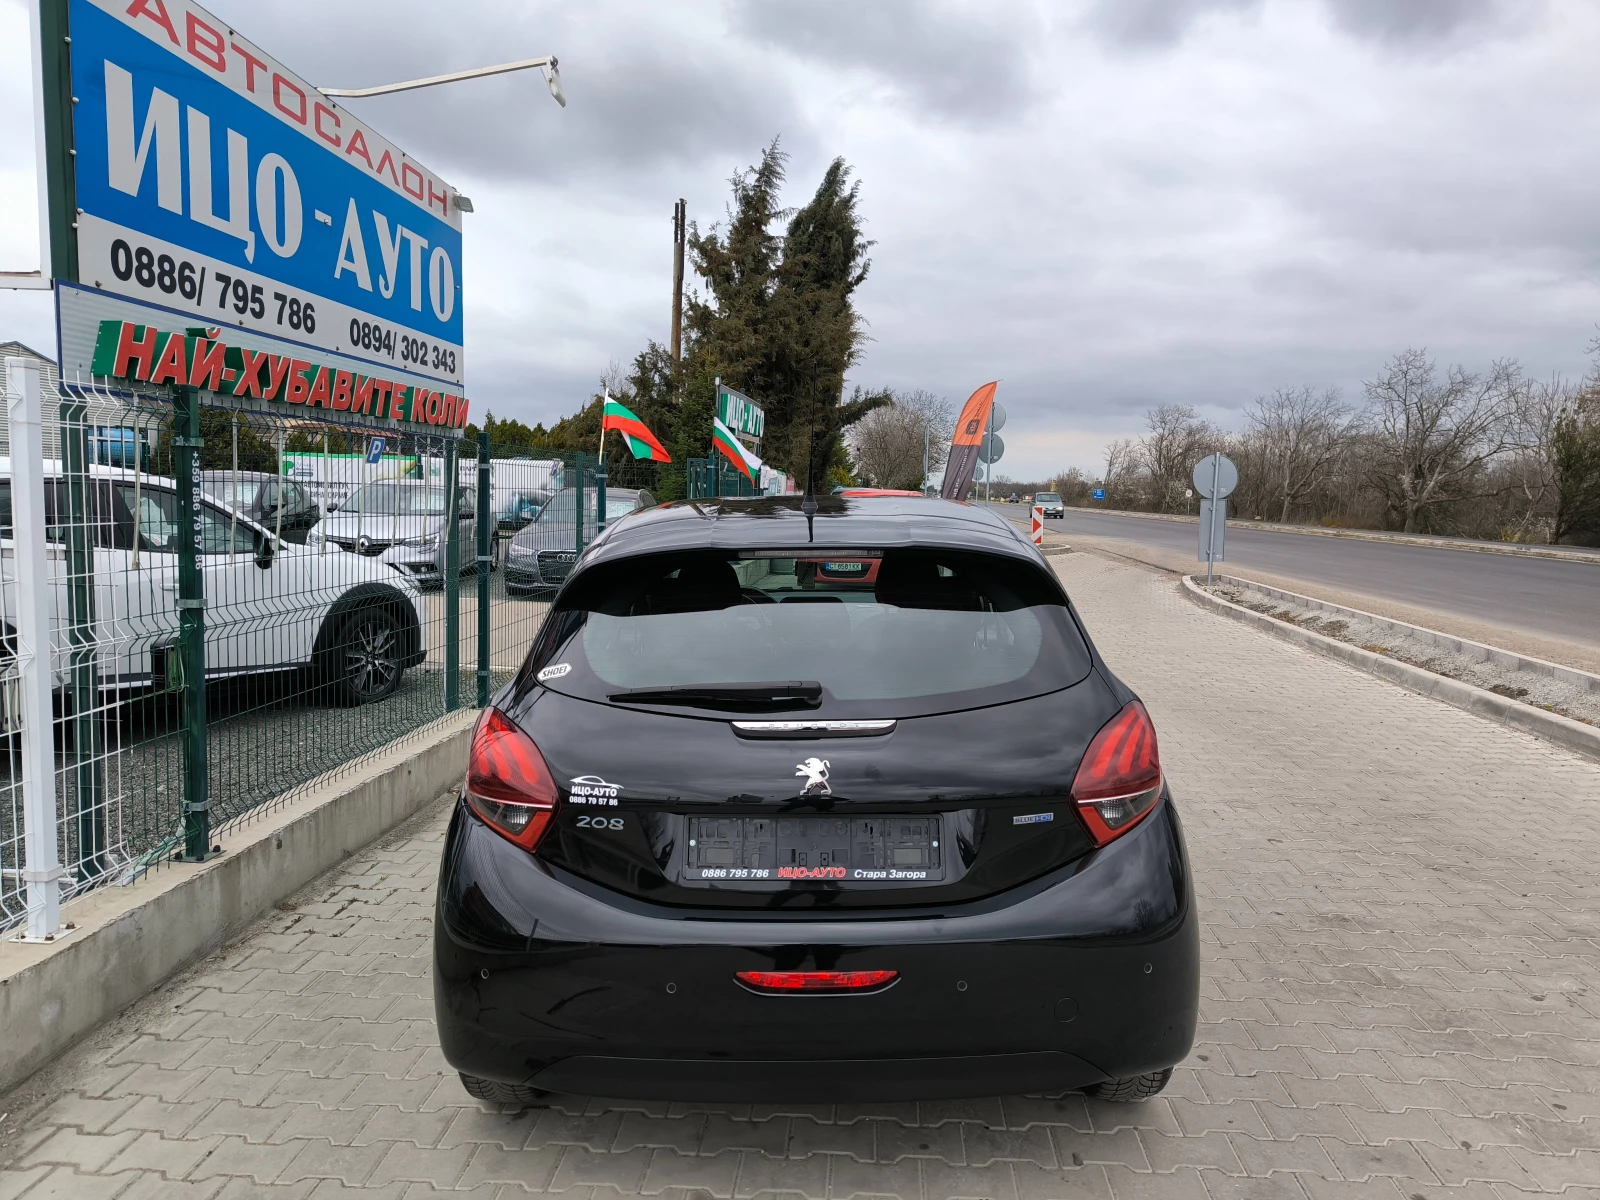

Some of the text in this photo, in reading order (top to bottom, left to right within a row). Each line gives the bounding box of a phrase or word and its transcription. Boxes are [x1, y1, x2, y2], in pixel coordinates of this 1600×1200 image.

[126, 0, 448, 217] АВТОСАЛОН
[110, 238, 316, 334] 0886/ 795 786
[350, 317, 456, 374] 0894/ 302 343
[112, 320, 470, 429] НАЙ-ХУБАВИТЕ КОЛИ
[191, 450, 203, 570] +359 886 79 57 86
[541, 665, 568, 678] SHOEI
[571, 785, 618, 797] ИЦО-АУТО
[576, 815, 625, 831] 208
[701, 866, 927, 880] 0886 795 786 ИЦО-АУТО Стара Загора
